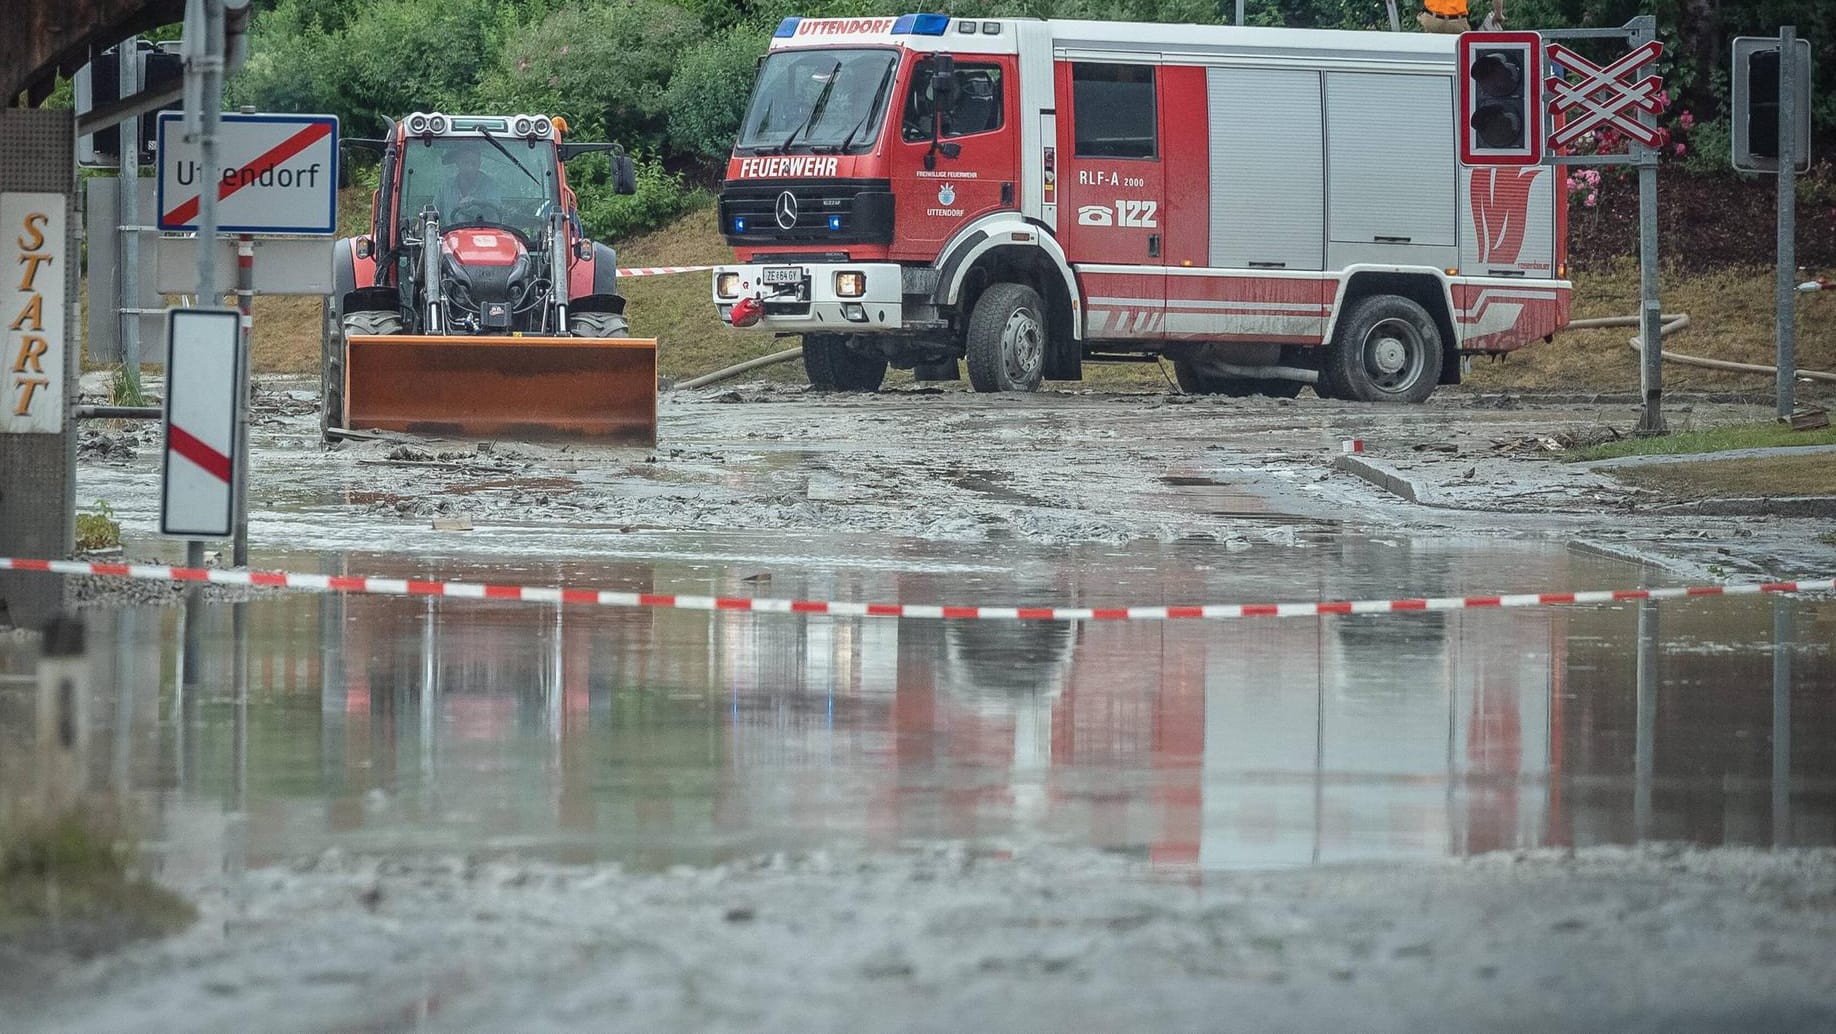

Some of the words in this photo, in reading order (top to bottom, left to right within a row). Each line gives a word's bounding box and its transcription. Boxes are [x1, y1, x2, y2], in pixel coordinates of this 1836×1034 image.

[799, 19, 892, 35] UTTENDORF
[177, 160, 320, 188] Uendorf
[740, 158, 838, 178] FEUERWEHR
[1079, 170, 1119, 186] RLF-A
[1124, 178, 1144, 187] 2000
[927, 208, 964, 217] UTTENDORF
[1115, 200, 1157, 228] 122
[9, 211, 53, 416] START
